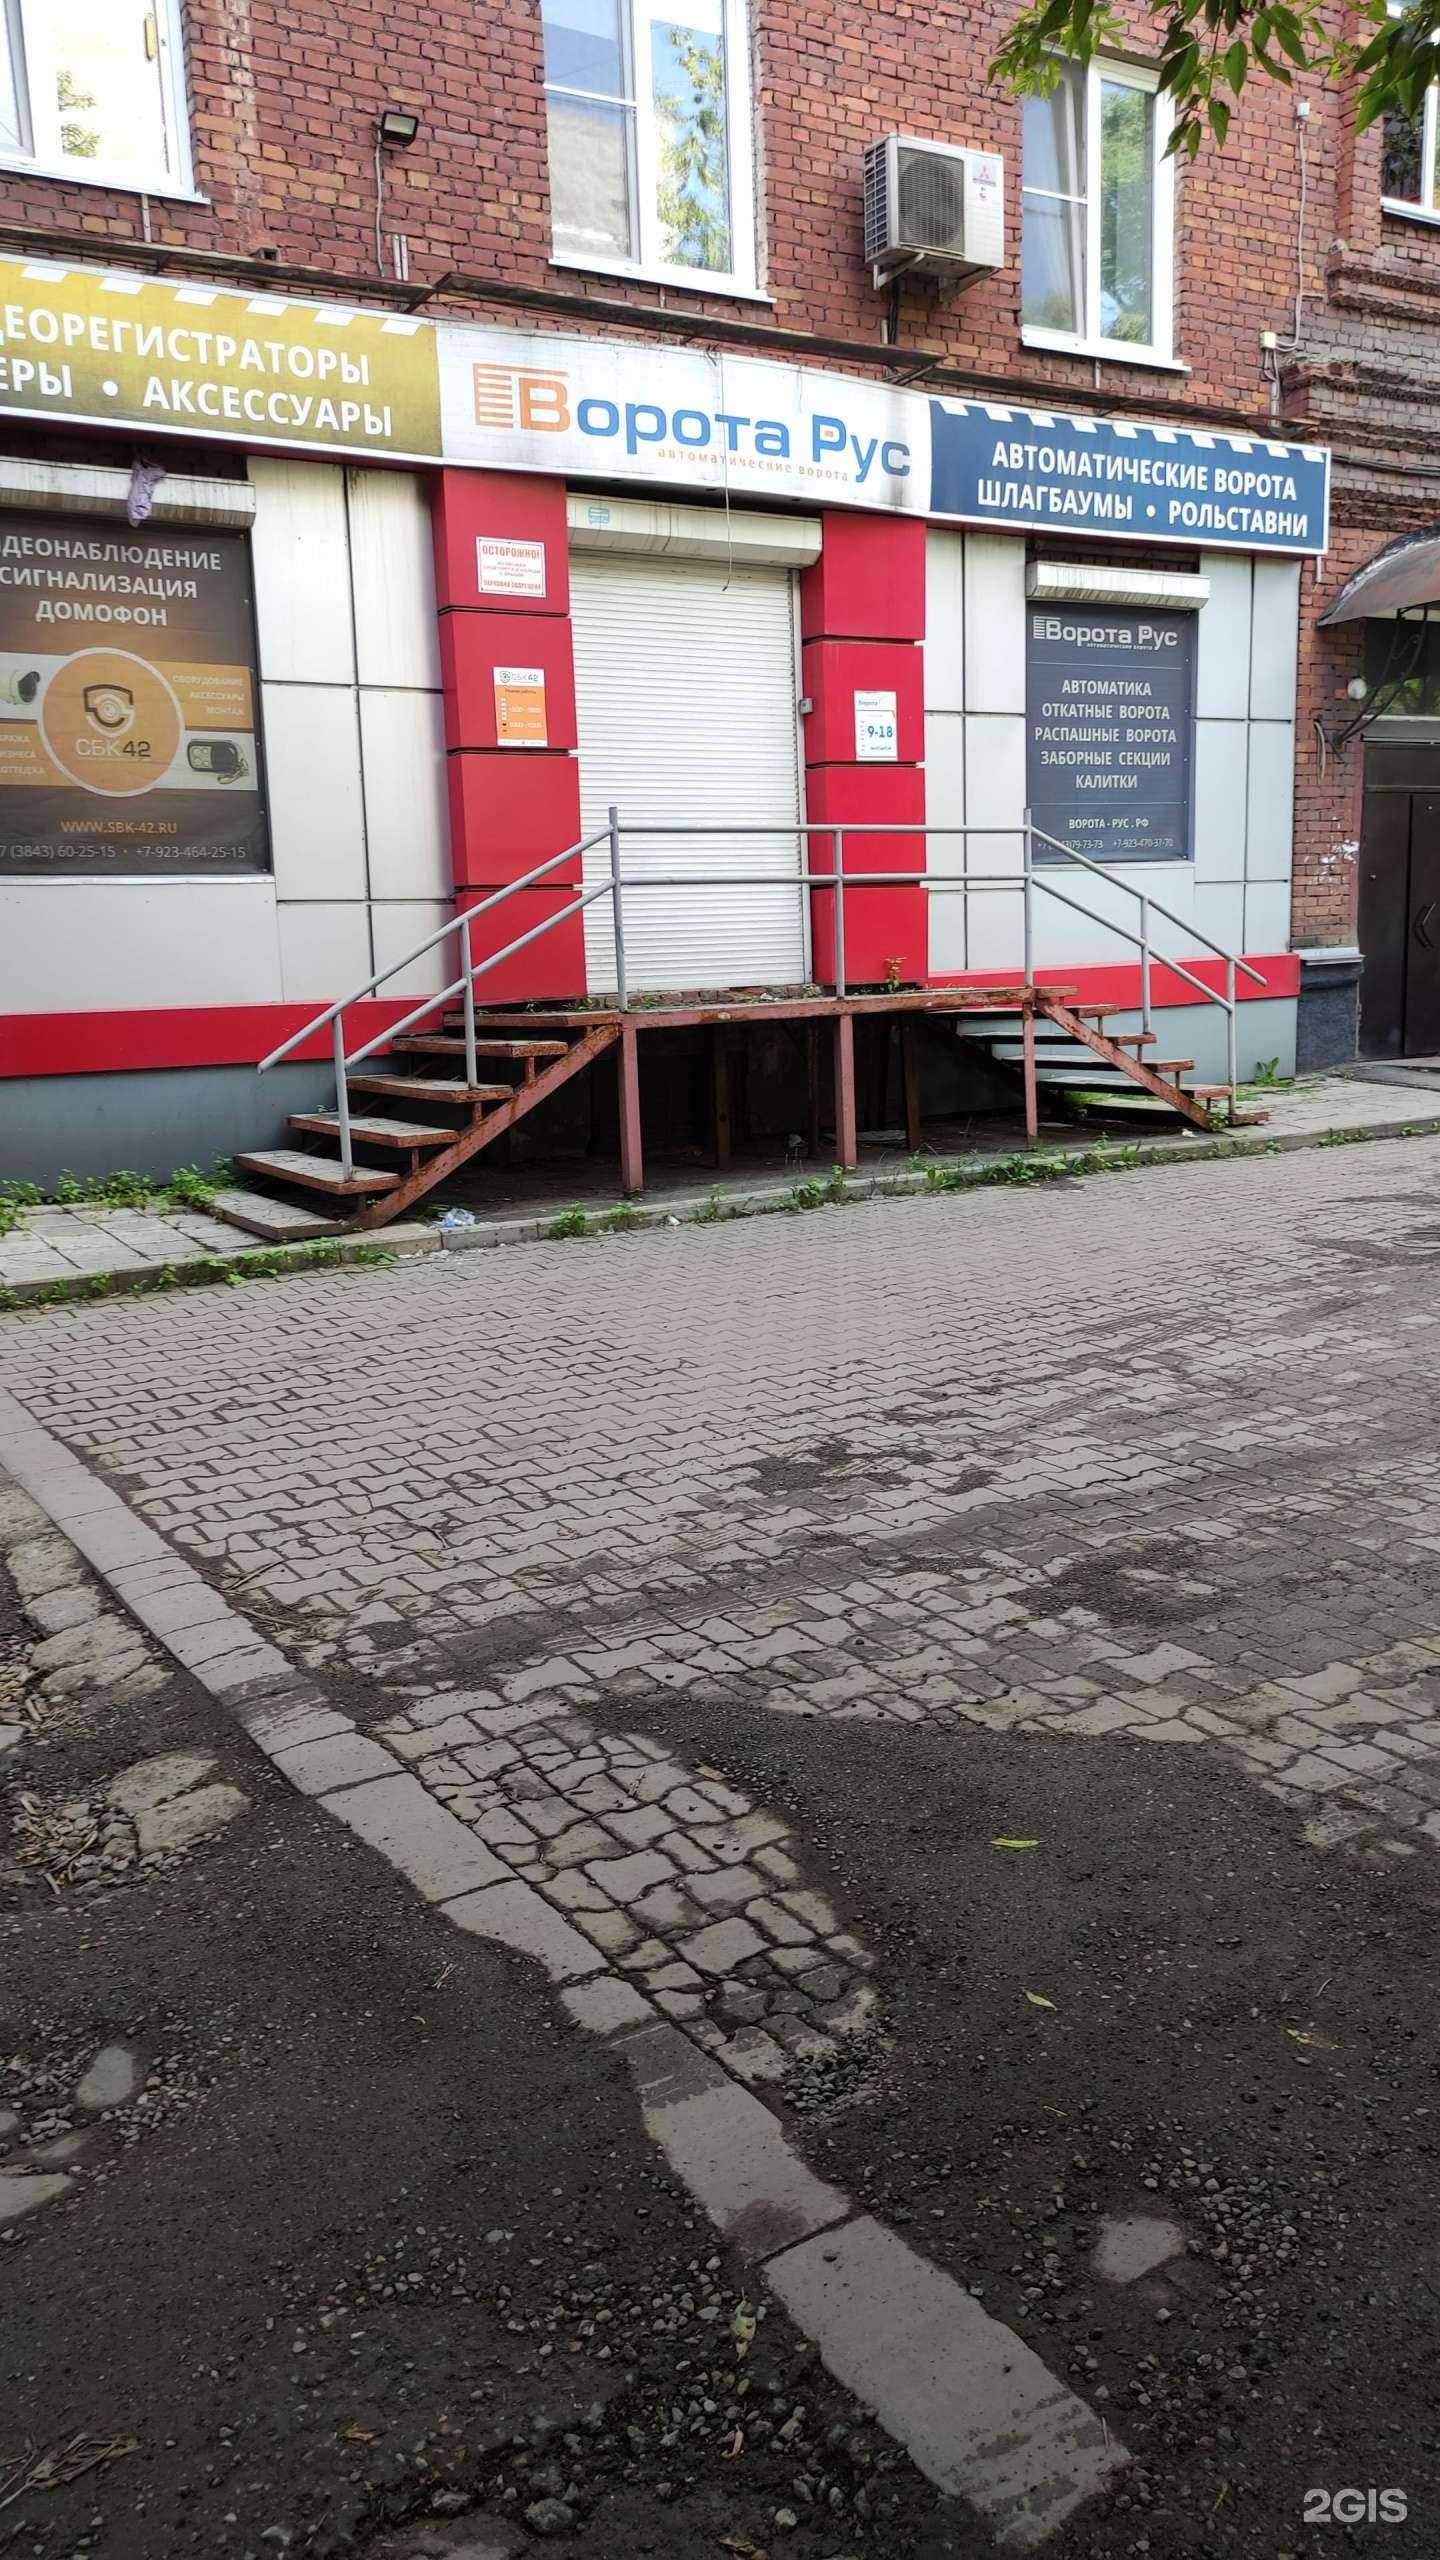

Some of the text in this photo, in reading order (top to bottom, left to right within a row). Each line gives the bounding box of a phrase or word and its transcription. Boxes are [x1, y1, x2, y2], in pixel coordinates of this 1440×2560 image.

[0, 303, 370, 386] ЕОРЕГИСТРАТОРЫ
[142, 376, 393, 437] АКСЕССУАРЫ
[519, 376, 912, 484] Ворота Рус
[798, 464, 849, 482] ворота
[992, 441, 1297, 501] АВТОМАТИЧЕСКИЕ ВОРОТА
[977, 478, 1309, 538] ШЛАГБАУМЫ РОЛЬСТАВНИ
[0, 535, 222, 571] ДЕОНАБЛЮДЕНИЕ
[0, 566, 198, 600] СИГНАЛИЗАЦИЯ
[35, 600, 168, 626] ДОМОФОН
[1046, 620, 1178, 651] Ворота Рус
[1062, 679, 1152, 696] АВТОМАТИКА
[1042, 703, 1170, 720] ОТКАТНЫЕ ВОРОТА
[867, 725, 893, 738] 9-18
[1035, 726, 1177, 743] РАСПАШНЫЕ ВОРОТА
[1040, 751, 1171, 768] ЗАБОРНЫЕ СЕКЦИИ
[1076, 774, 1138, 789] КАЛИТКИ
[60, 819, 178, 835] WWW.SBK-42.RU
[57, 845, 116, 858] 60-25-15
